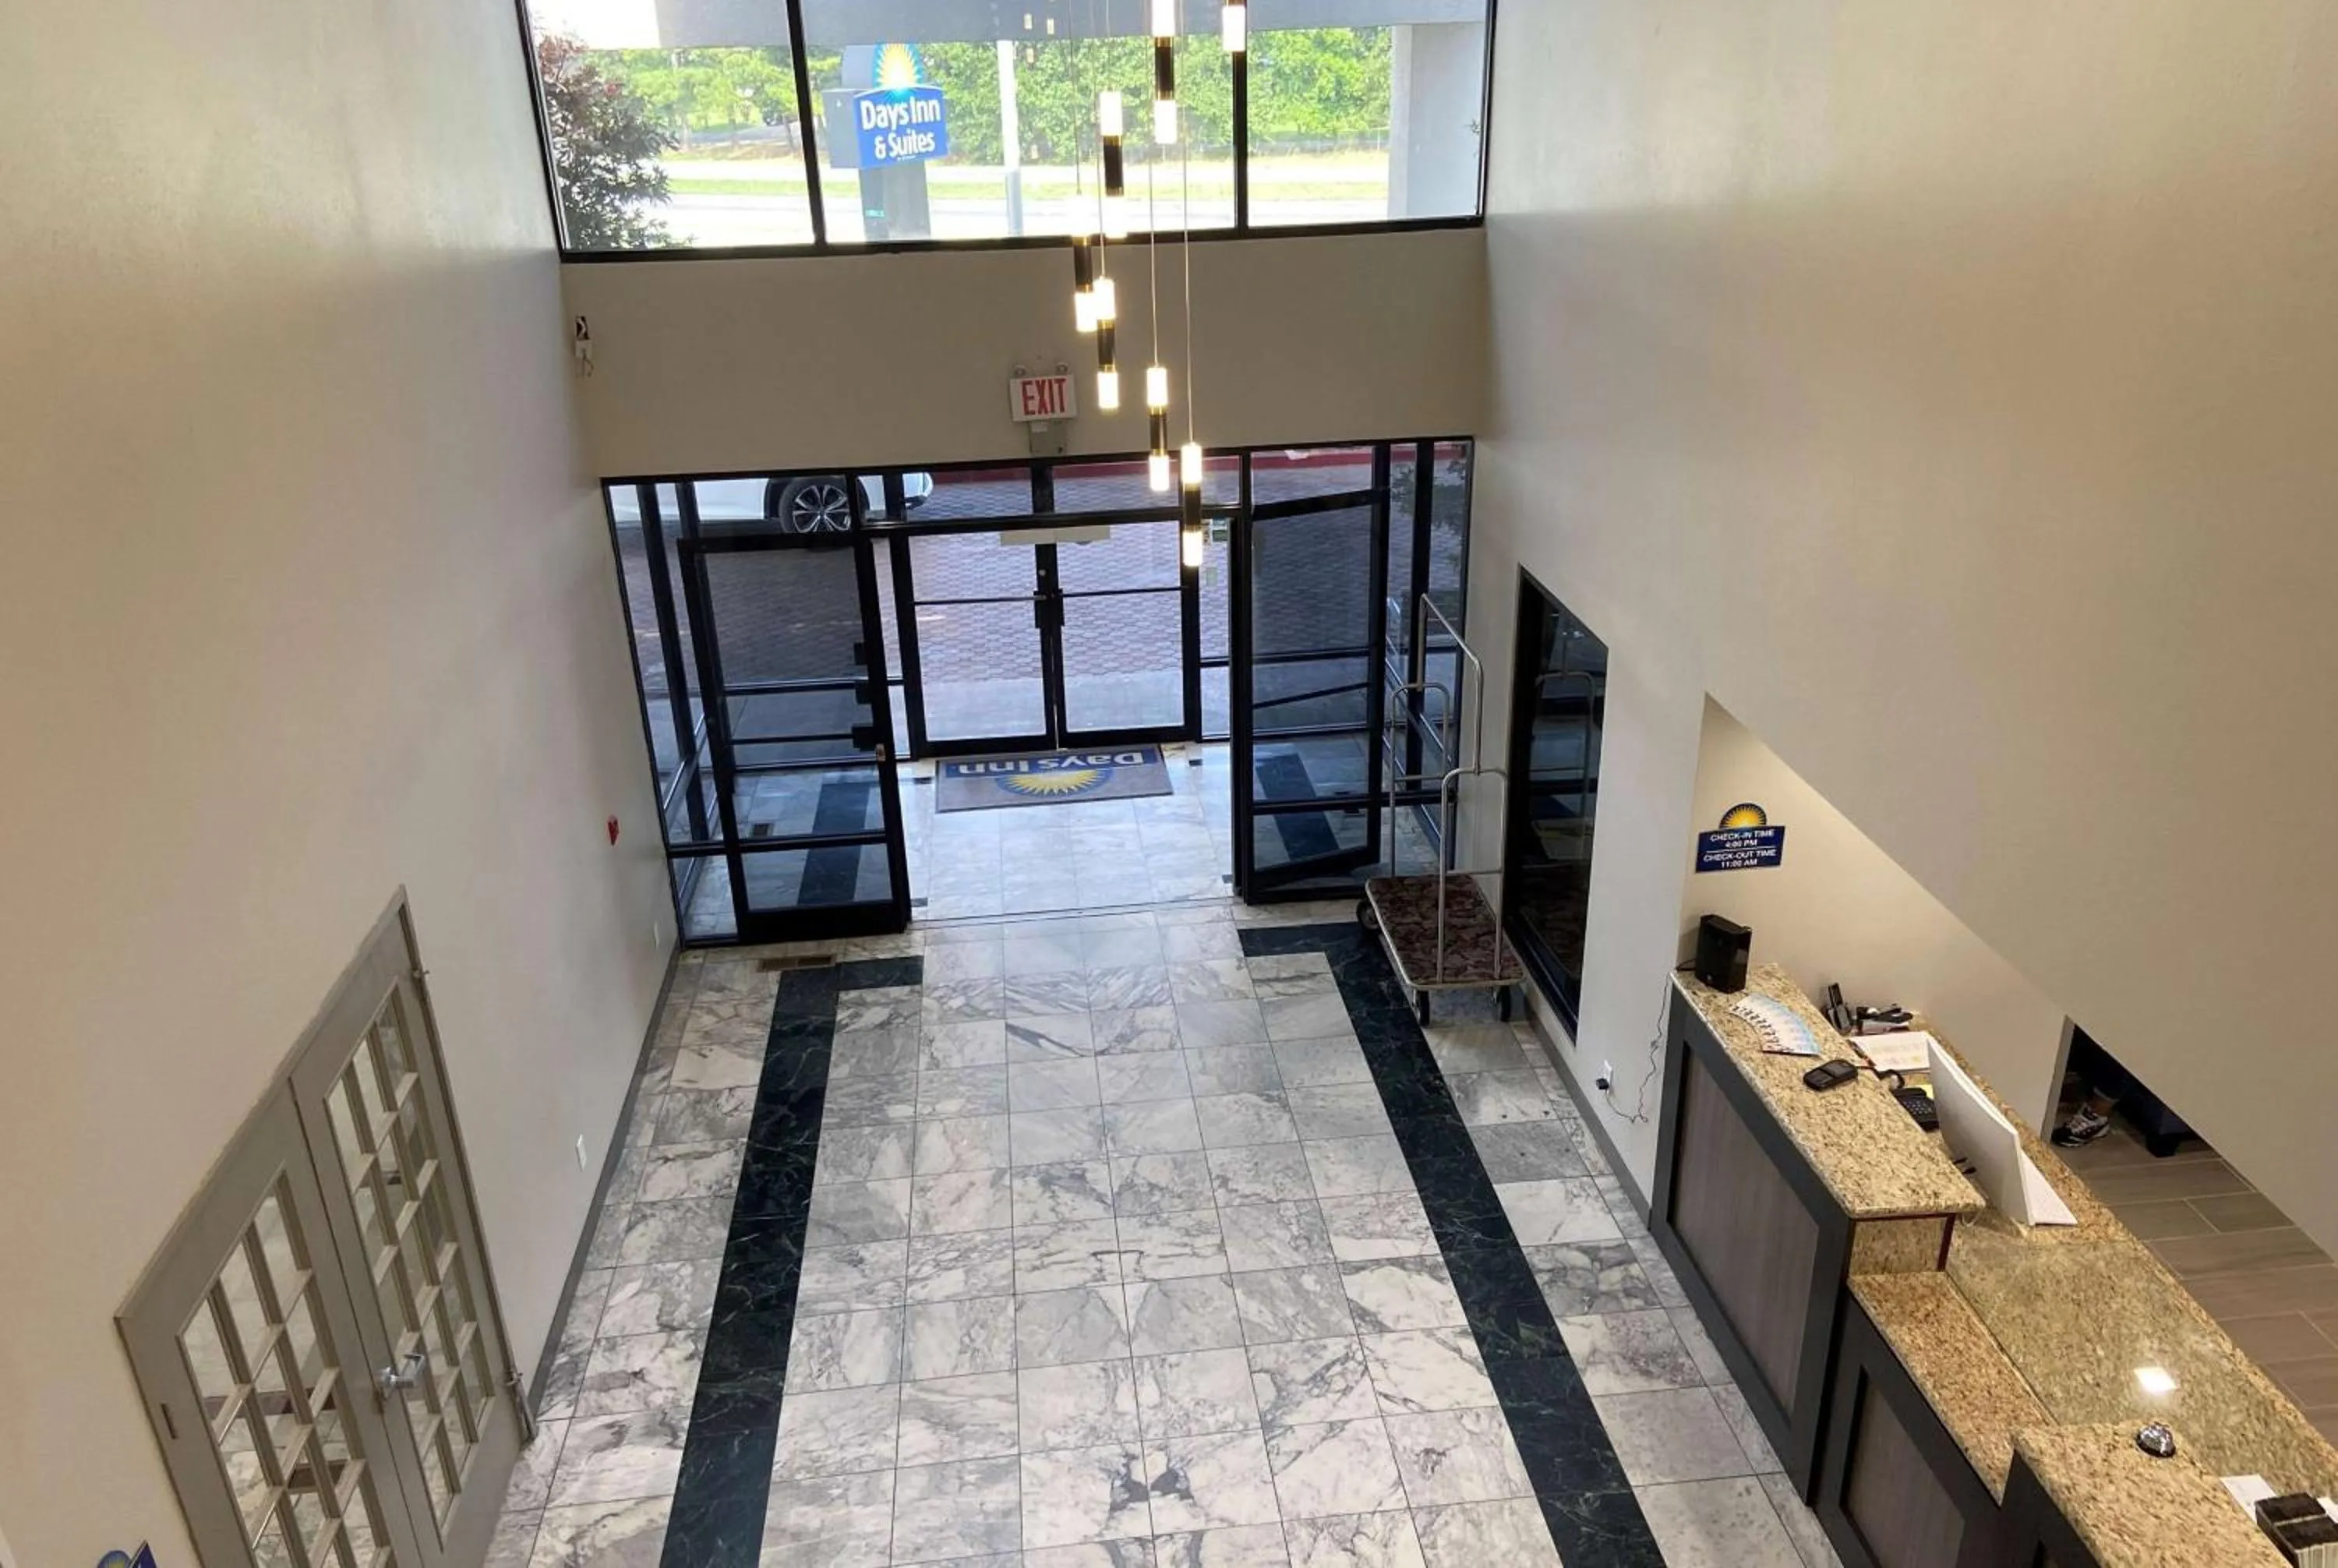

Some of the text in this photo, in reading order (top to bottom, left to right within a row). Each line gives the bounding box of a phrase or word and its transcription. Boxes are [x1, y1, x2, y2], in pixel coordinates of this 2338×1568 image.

[860, 96, 941, 130] Days Inn
[874, 128, 935, 160] & Suites
[1022, 378, 1066, 415] EXIT
[958, 752, 1143, 774] Days Inn
[1710, 829, 1774, 842] CHECK-IN TIME
[1704, 849, 1776, 862] CHECK-OUT TIME
